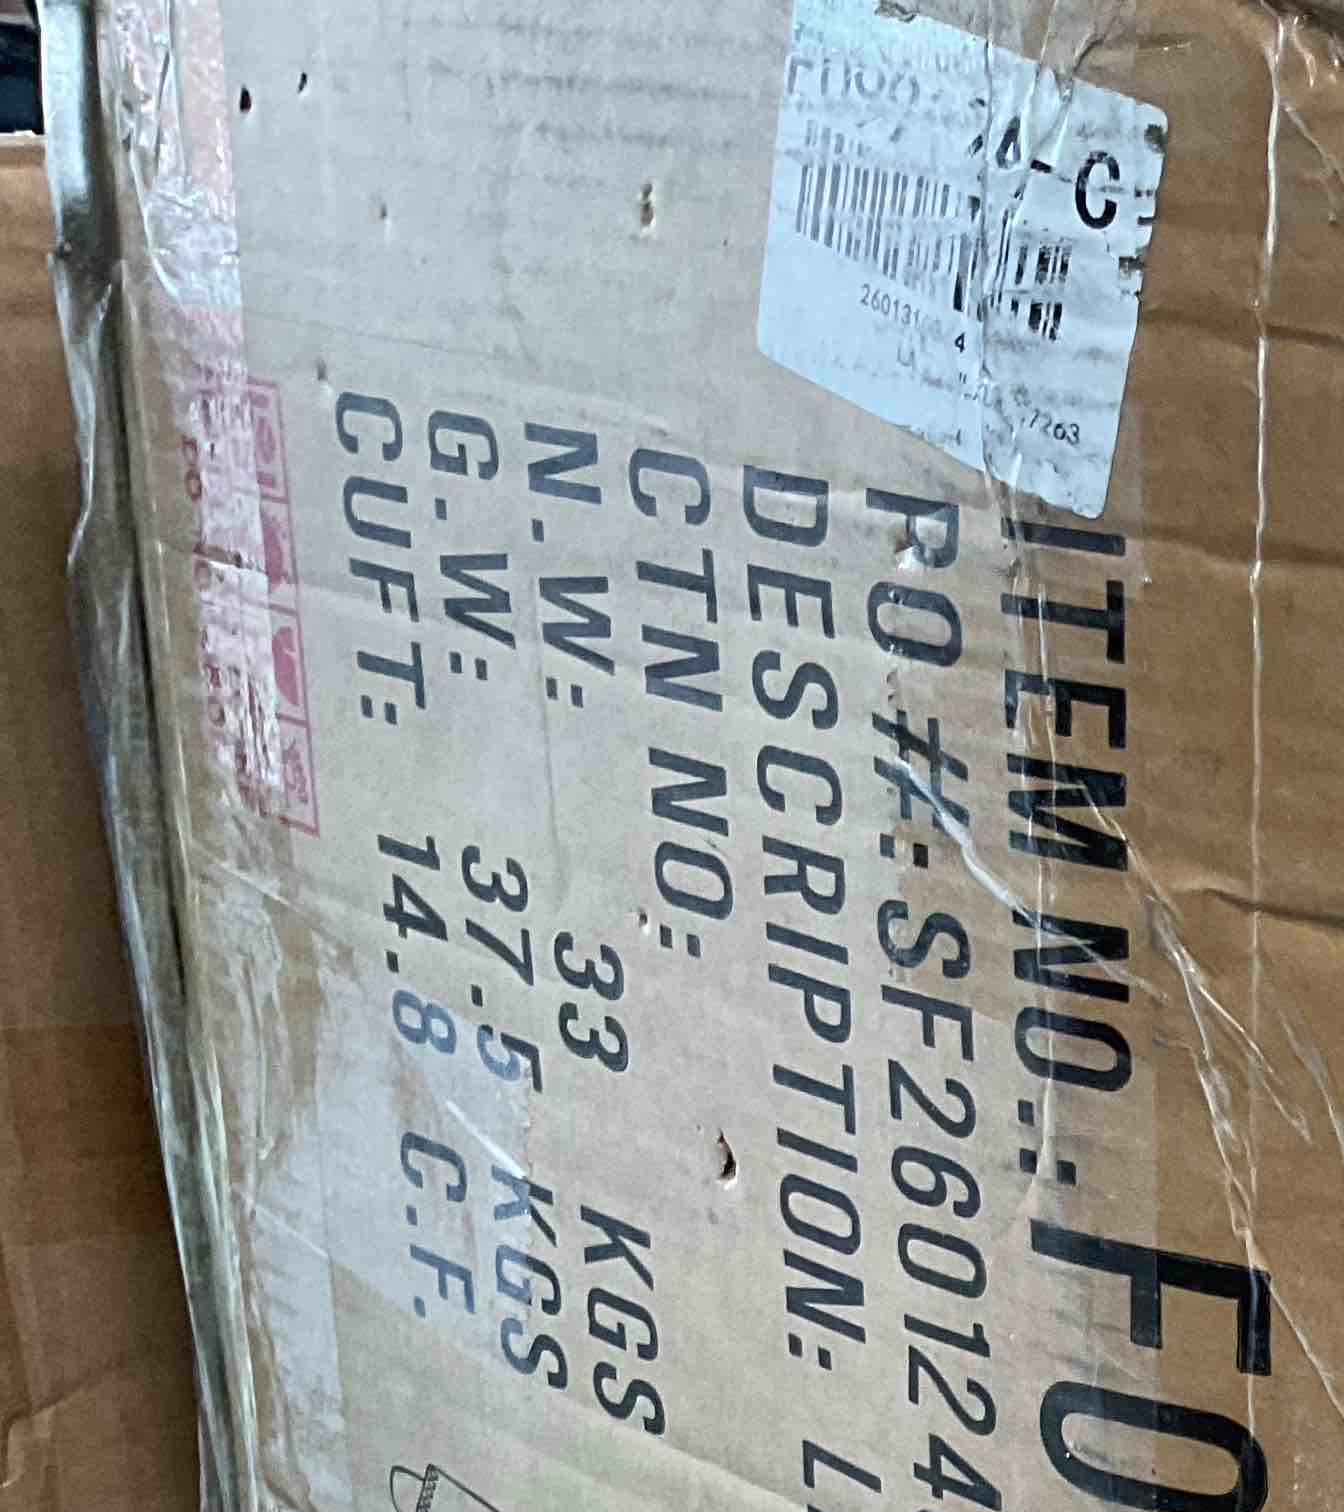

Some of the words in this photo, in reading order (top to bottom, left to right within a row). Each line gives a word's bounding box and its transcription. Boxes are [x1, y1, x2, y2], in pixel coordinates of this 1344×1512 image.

[335, 391, 425, 725] CUFT:
[629, 448, 723, 713] CTN
[866, 488, 962, 667] PO
[1000, 516, 1129, 872] ITEM
[378, 834, 457, 1055] 14.8
[648, 747, 734, 958] NO:
[743, 465, 866, 1370] DESCRIPTION:
[462, 844, 543, 1093] 37.5
[554, 930, 629, 1073] 33
[400, 1131, 475, 1318] C.F.
[490, 1164, 567, 1389] KGS
[580, 1204, 666, 1435] KGS
